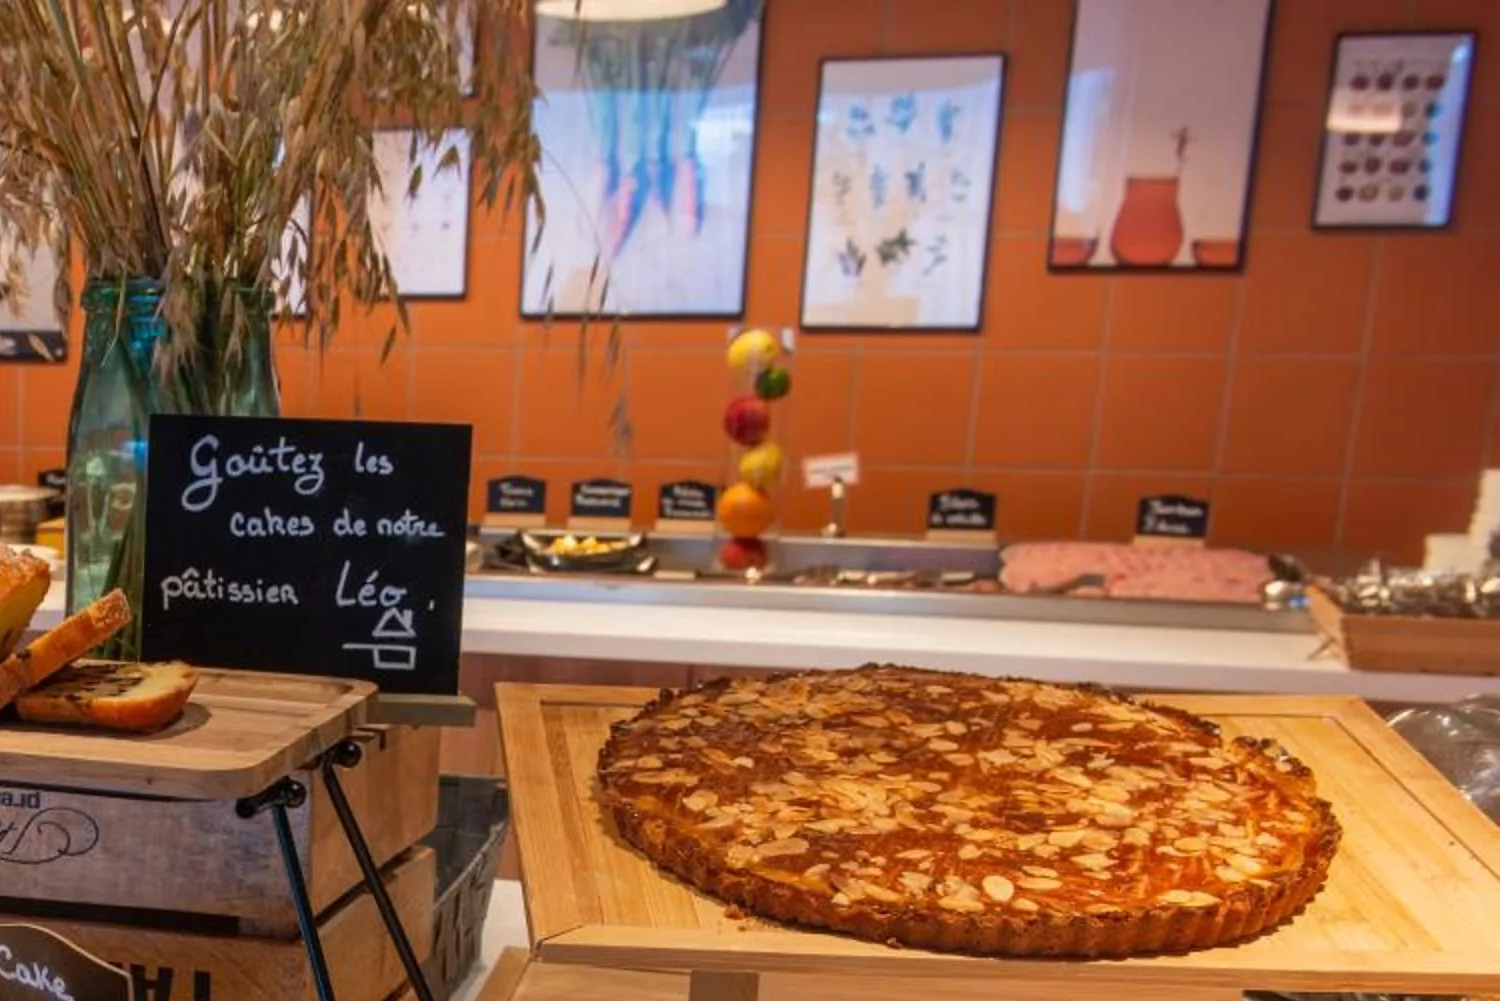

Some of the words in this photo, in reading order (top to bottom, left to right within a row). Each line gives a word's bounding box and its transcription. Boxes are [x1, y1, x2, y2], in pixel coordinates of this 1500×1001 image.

[181, 435, 324, 511] Goûtez
[354, 441, 394, 475] les
[230, 507, 314, 537] cakes
[333, 509, 367, 537] de
[377, 509, 445, 537] notre
[161, 568, 299, 610] pâtissier
[336, 560, 408, 606] Léo
